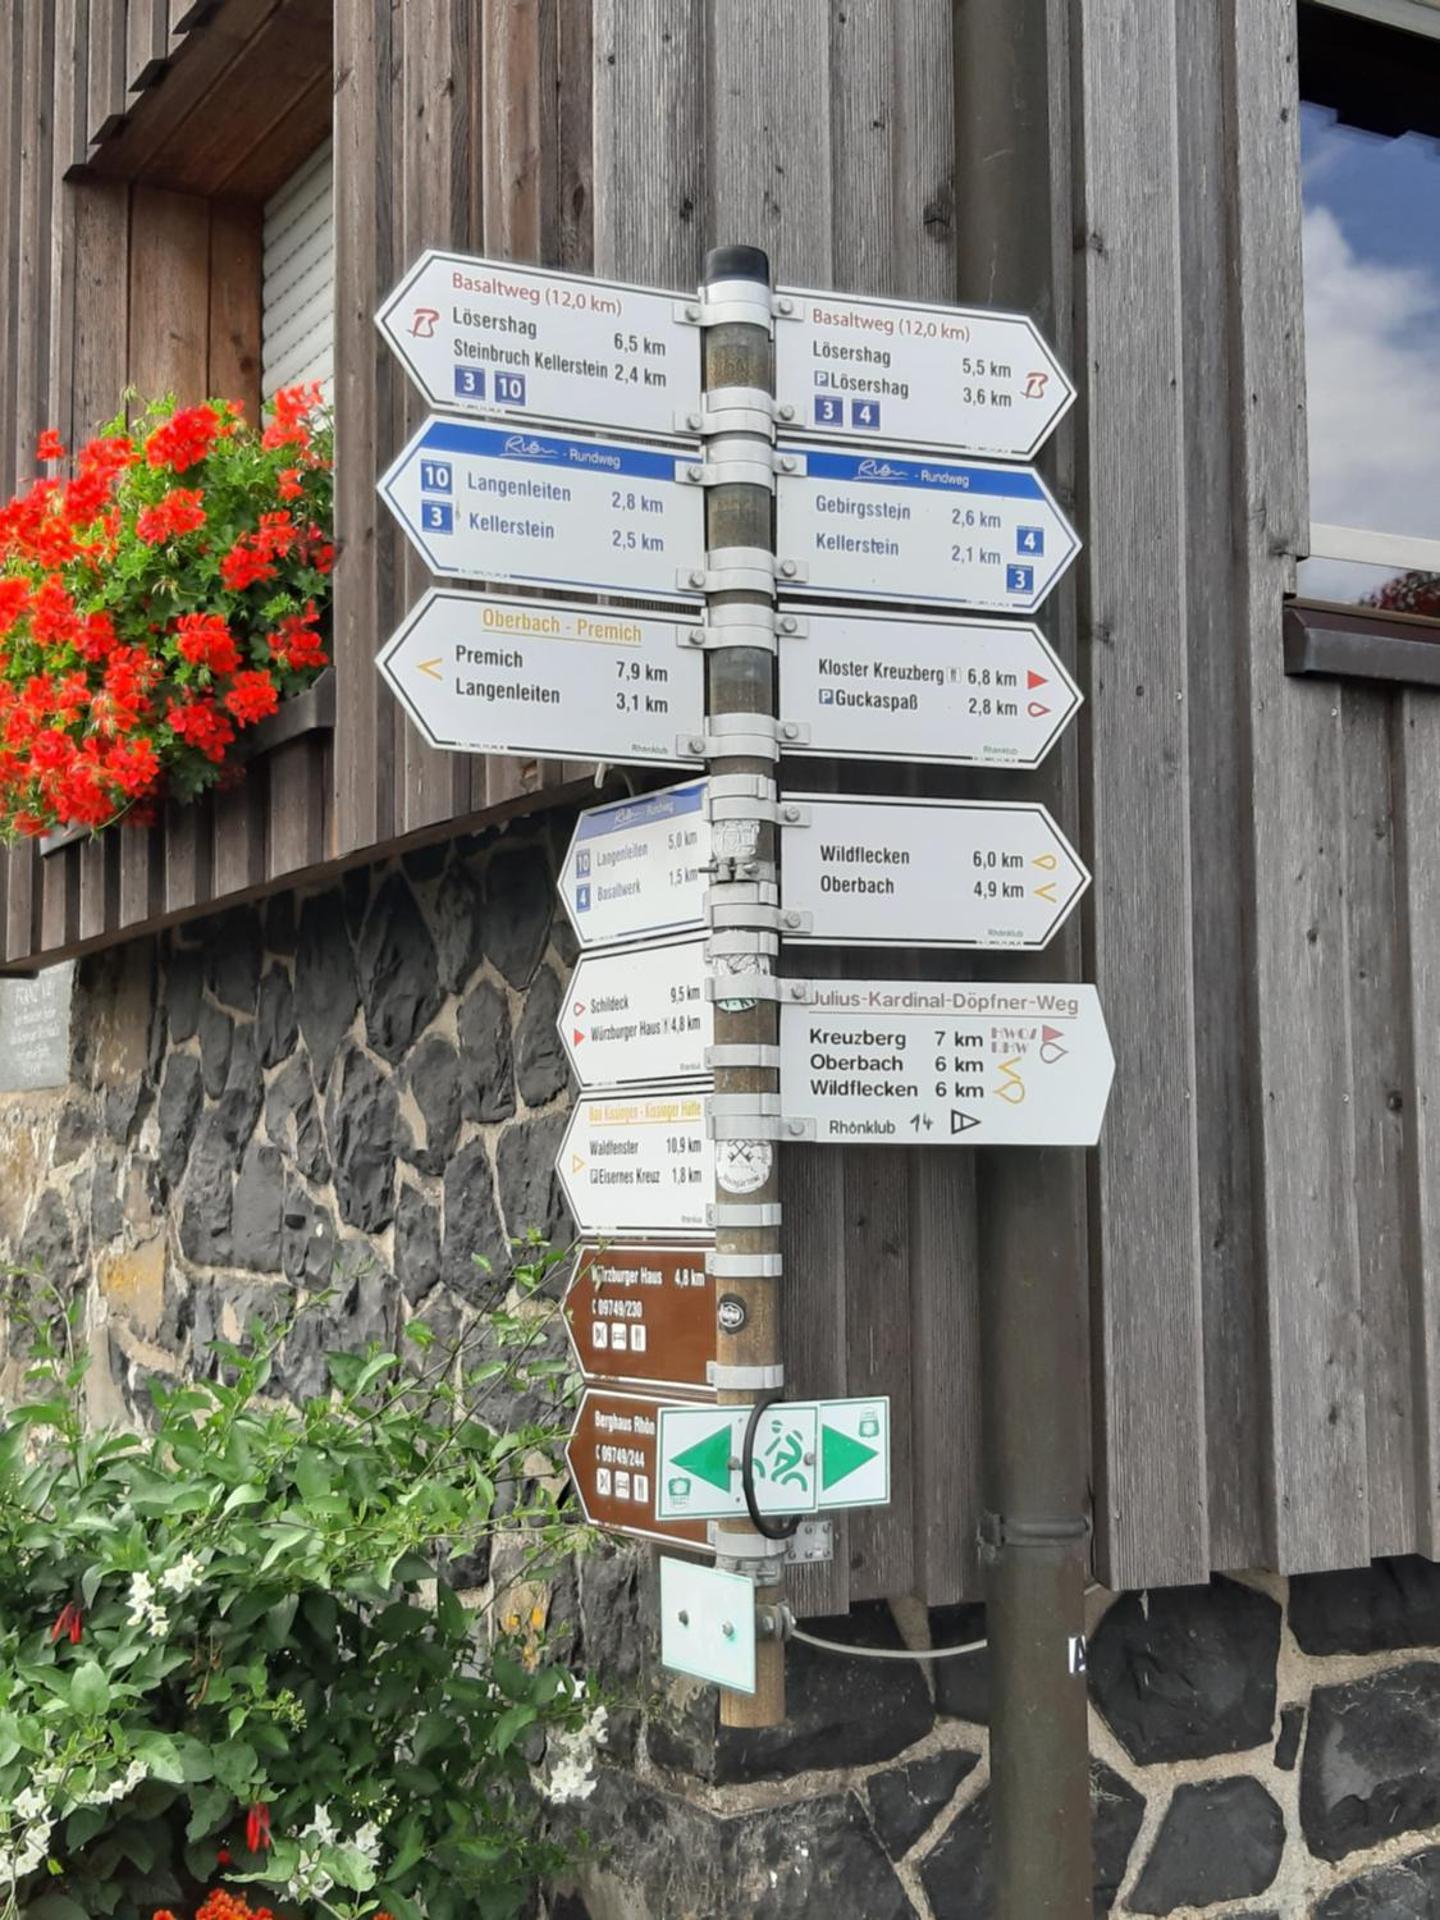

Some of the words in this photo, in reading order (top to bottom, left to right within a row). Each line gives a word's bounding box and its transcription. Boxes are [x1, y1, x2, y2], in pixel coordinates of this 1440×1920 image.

[452, 272, 540, 305] Basaltweg
[545, 289, 586, 311] (12,0
[590, 293, 622, 317] km)
[452, 306, 537, 340] Lösershag
[614, 333, 639, 354] 6,5
[643, 336, 666, 356] km
[813, 308, 894, 335] Basaltweg
[899, 319, 937, 339] (12,0
[940, 323, 971, 343] km)
[453, 338, 530, 366] Steinbruch
[535, 349, 608, 379] Kellerstein
[614, 364, 639, 385] 2,4
[644, 367, 666, 387] km
[813, 340, 891, 367] Lösershag
[962, 358, 985, 376] 5,5
[990, 361, 1011, 379] km
[463, 372, 476, 392] 3
[500, 378, 522, 399] 10
[831, 373, 909, 399] Lösershag
[963, 387, 986, 406] 3,6
[990, 390, 1012, 408] km
[822, 401, 834, 420] 3
[860, 405, 872, 423] 4
[569, 448, 621, 470] Rundweg
[425, 466, 449, 486] 10
[467, 472, 571, 502] Langenleiten
[611, 491, 635, 512] 2,8
[641, 494, 664, 514] km
[921, 469, 970, 487] Rundweg
[431, 507, 443, 527] 3
[469, 512, 555, 539] Kellerstein
[611, 530, 636, 551] 2,5
[641, 533, 664, 552] km
[952, 508, 975, 527] 2,6
[980, 512, 1001, 528] km
[1024, 532, 1036, 550] 4
[816, 532, 899, 555] Kellerstein
[952, 546, 973, 564] 2,1
[980, 548, 1001, 565] km
[1015, 571, 1026, 589] 3
[483, 608, 560, 634] Oberbach
[577, 618, 642, 643] Premich
[455, 645, 523, 668] Premich
[616, 661, 641, 681] 7,9
[645, 663, 668, 682] km
[818, 658, 868, 677] Kloster
[873, 661, 944, 685] Kreuzberg
[968, 668, 991, 687] 6,8
[995, 670, 1017, 687] km
[456, 677, 560, 704] Langenleiten
[616, 693, 640, 713] 3,1
[645, 694, 668, 713] km
[836, 689, 918, 711] Guckaspaß
[968, 698, 991, 717] 2,8
[996, 699, 1018, 717] km
[597, 843, 648, 867] Langenleiten
[668, 833, 682, 850] 5,0
[684, 829, 697, 845] km
[820, 845, 910, 865] Wildflecken
[973, 851, 996, 869] 6,0
[1001, 851, 1023, 868] km
[669, 871, 682, 886] 1,5
[684, 868, 699, 882] km
[820, 875, 894, 894] Oberbach
[973, 881, 996, 899] 4,9
[1002, 881, 1024, 898] km
[590, 994, 628, 1014] Schildeck
[687, 983, 700, 1000] km
[812, 989, 1079, 1015] Julius-Kardinal-Döpfner-Weg
[640, 1020, 661, 1036] Haus
[687, 1015, 701, 1031] km
[809, 1028, 907, 1050] Kreuzberg
[934, 1031, 946, 1047] 7
[955, 1030, 983, 1047] km
[810, 1054, 903, 1072] Oberbach
[935, 1056, 947, 1073] 6
[955, 1055, 984, 1073] km
[810, 1079, 918, 1098] Wildflecken
[935, 1081, 947, 1098] 6
[955, 1080, 984, 1098] km
[829, 1118, 896, 1136] Rhönklub
[590, 1139, 638, 1156] Waldfenster
[666, 1137, 685, 1154] 10,9
[688, 1137, 701, 1153] km
[599, 1168, 634, 1185] Eisernes
[636, 1167, 660, 1184] Kreuz
[672, 1168, 686, 1185] 1,8
[688, 1167, 701, 1183] km
[641, 1266, 662, 1286] Haus
[691, 1267, 705, 1287] km
[595, 1410, 632, 1432] Berghaus
